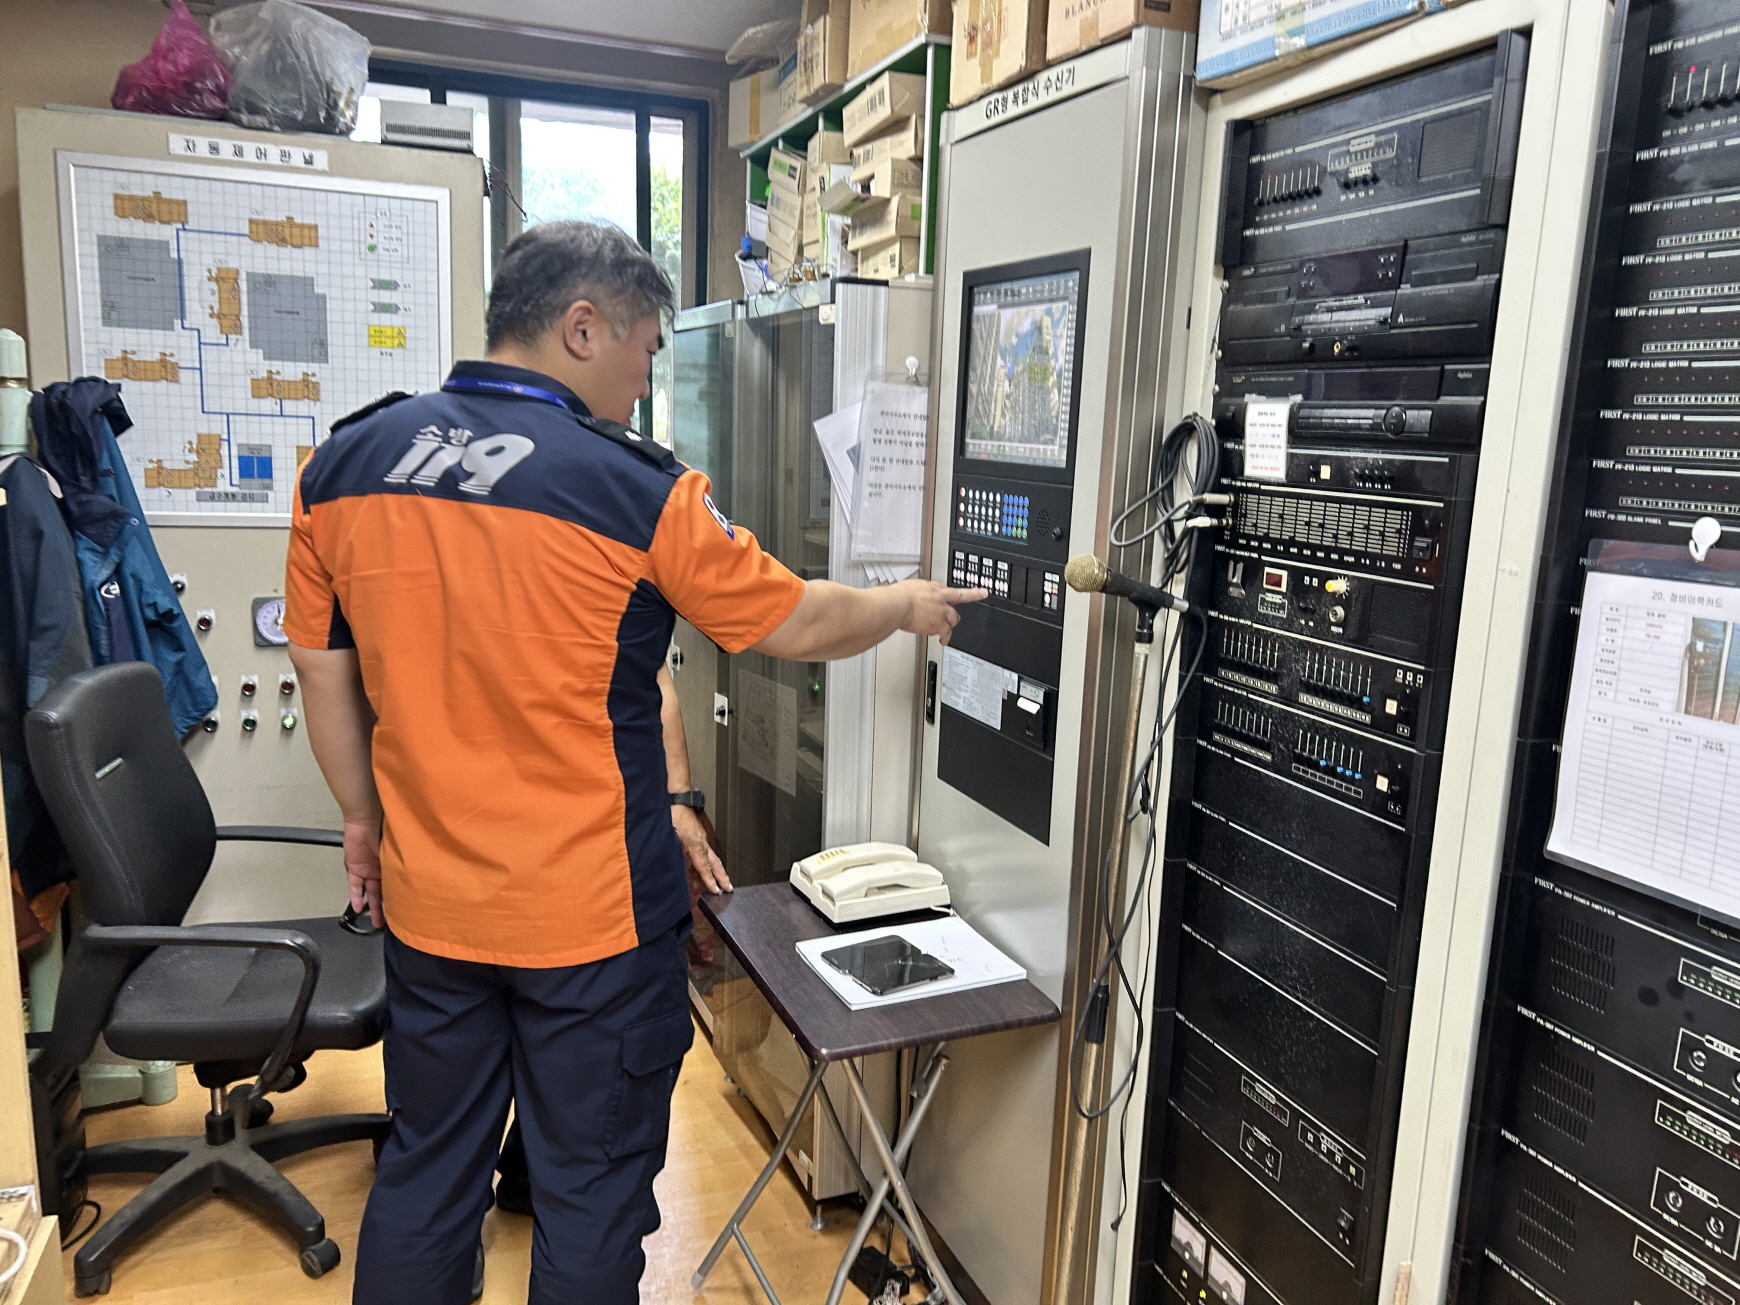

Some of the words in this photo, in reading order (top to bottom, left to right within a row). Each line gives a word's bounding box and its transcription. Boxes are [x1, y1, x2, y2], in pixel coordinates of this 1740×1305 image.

[1065, 0, 1107, 19] BLANC
[985, 91, 1009, 120] GR형
[1011, 79, 1040, 109] 복합식
[1043, 64, 1076, 97] 수신기
[1629, 202, 1653, 214] FIRST
[1622, 254, 1646, 266] FIRST
[1615, 306, 1638, 318] FIRST
[1607, 358, 1630, 368] FIRST
[1600, 409, 1622, 419] FIRST
[414, 425, 474, 446] 소방
[383, 433, 535, 495] 119
[1593, 459, 1615, 469] FIRST
[1584, 508, 1607, 519] FIRST
[1534, 876, 1555, 892] FIRST
[1517, 1004, 1537, 1021] FIRST
